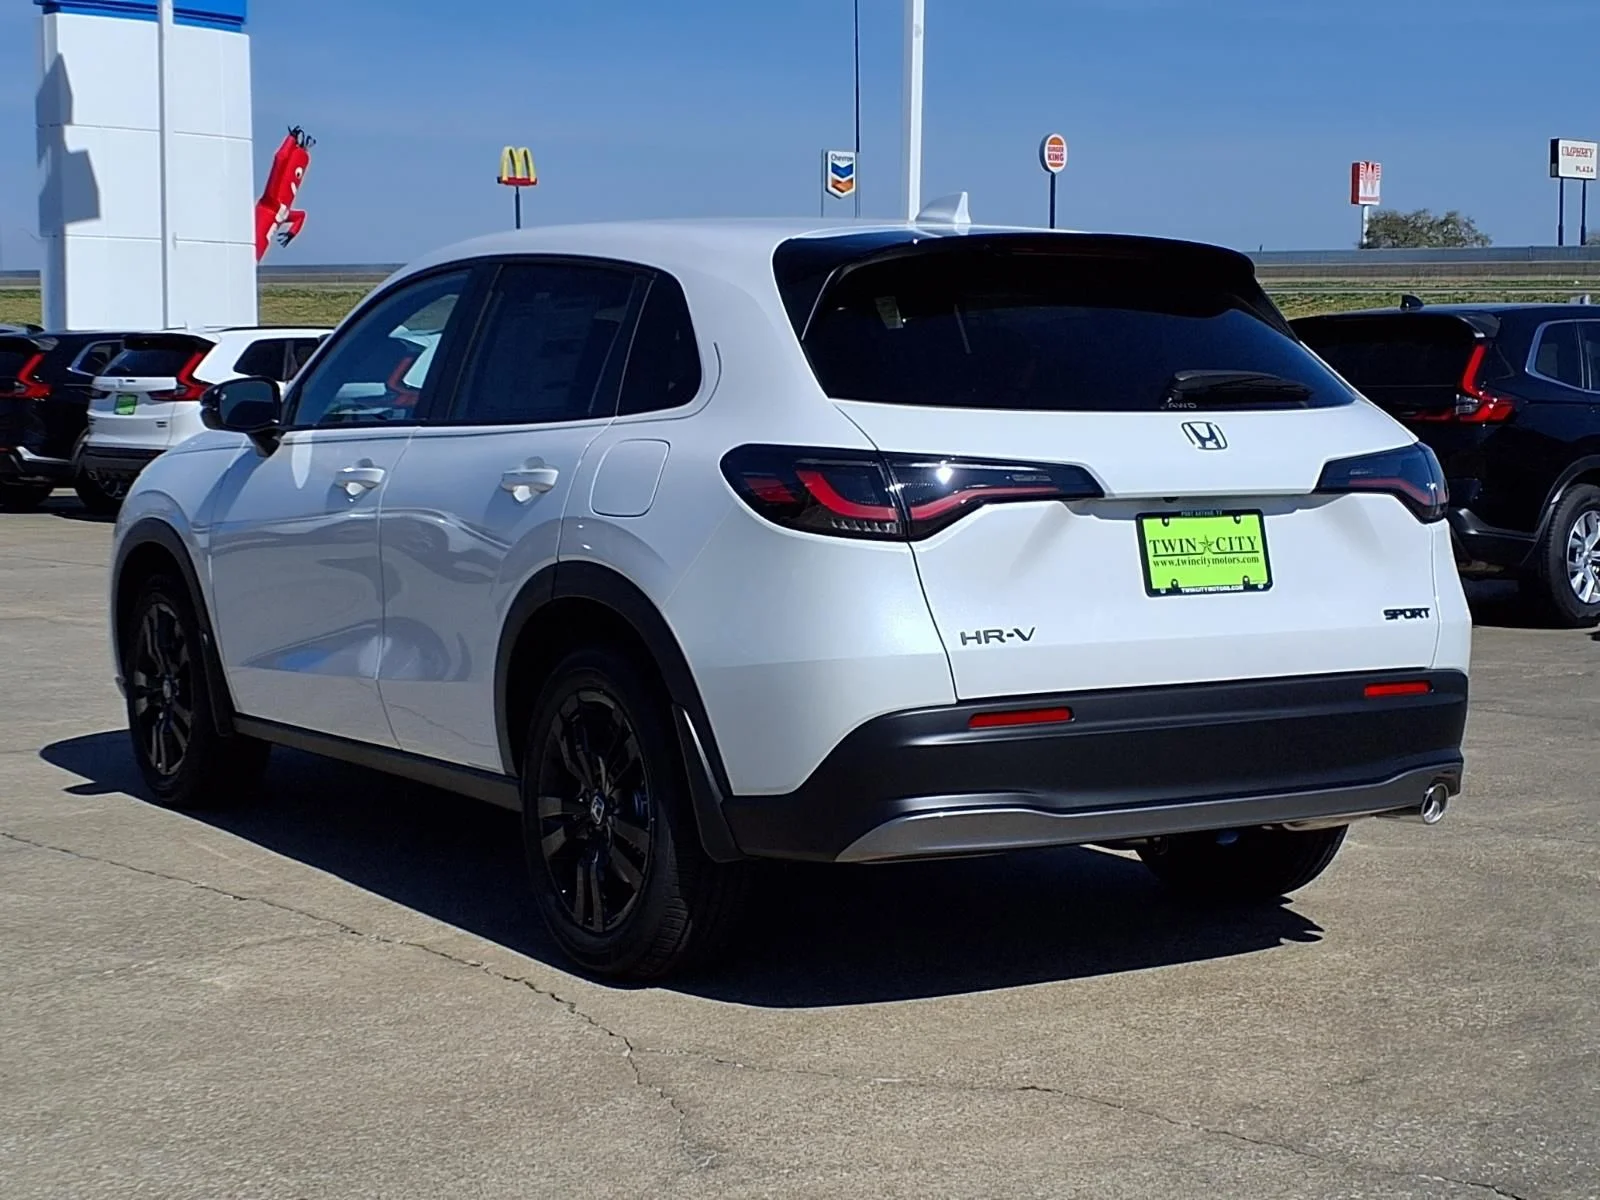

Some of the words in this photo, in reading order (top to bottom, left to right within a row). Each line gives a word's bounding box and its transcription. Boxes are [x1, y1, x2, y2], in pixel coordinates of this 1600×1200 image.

[1047, 153, 1065, 162] KING
[1575, 165, 1594, 173] PLAZA
[1149, 537, 1197, 554] TWIN
[1215, 535, 1257, 552] CITY
[1153, 555, 1260, 568] www.twincitymotors.com
[1383, 607, 1431, 620] SPORT
[960, 627, 1036, 646] HR-V
